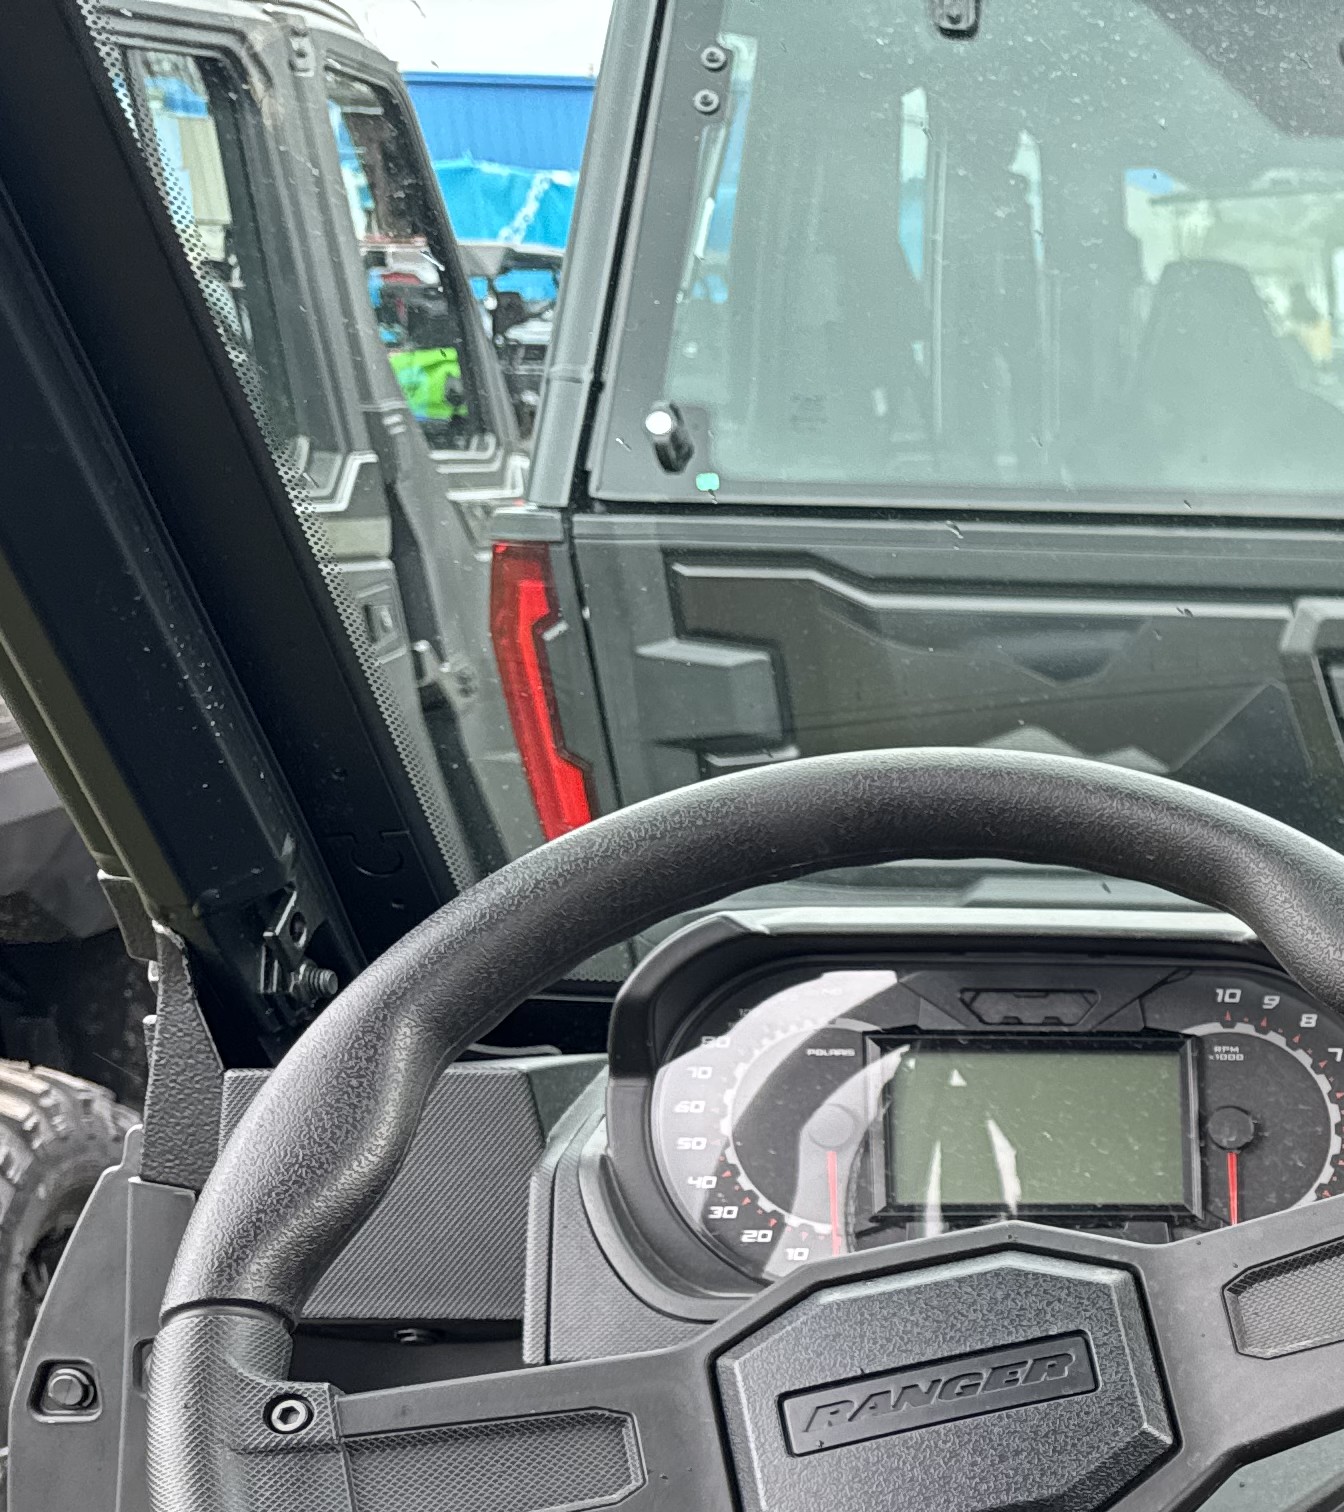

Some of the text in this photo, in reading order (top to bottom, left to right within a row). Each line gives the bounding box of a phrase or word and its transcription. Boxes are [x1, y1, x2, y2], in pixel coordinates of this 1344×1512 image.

[1215, 988, 1242, 1003] 10
[1262, 995, 1280, 1010] 9
[1300, 1013, 1318, 1028] 8
[701, 1036, 730, 1048] 80
[806, 1048, 856, 1057] POLARIS
[1214, 1046, 1240, 1054] RPM
[1328, 1047, 1344, 1062] 7
[686, 1066, 713, 1079] 70
[673, 1100, 706, 1113] 60
[676, 1137, 708, 1150] 50
[687, 1175, 718, 1189] 40
[708, 1206, 739, 1219] 30
[741, 1230, 773, 1243] 20
[786, 1248, 809, 1261] 10
[801, 1352, 1075, 1433] RANGER
